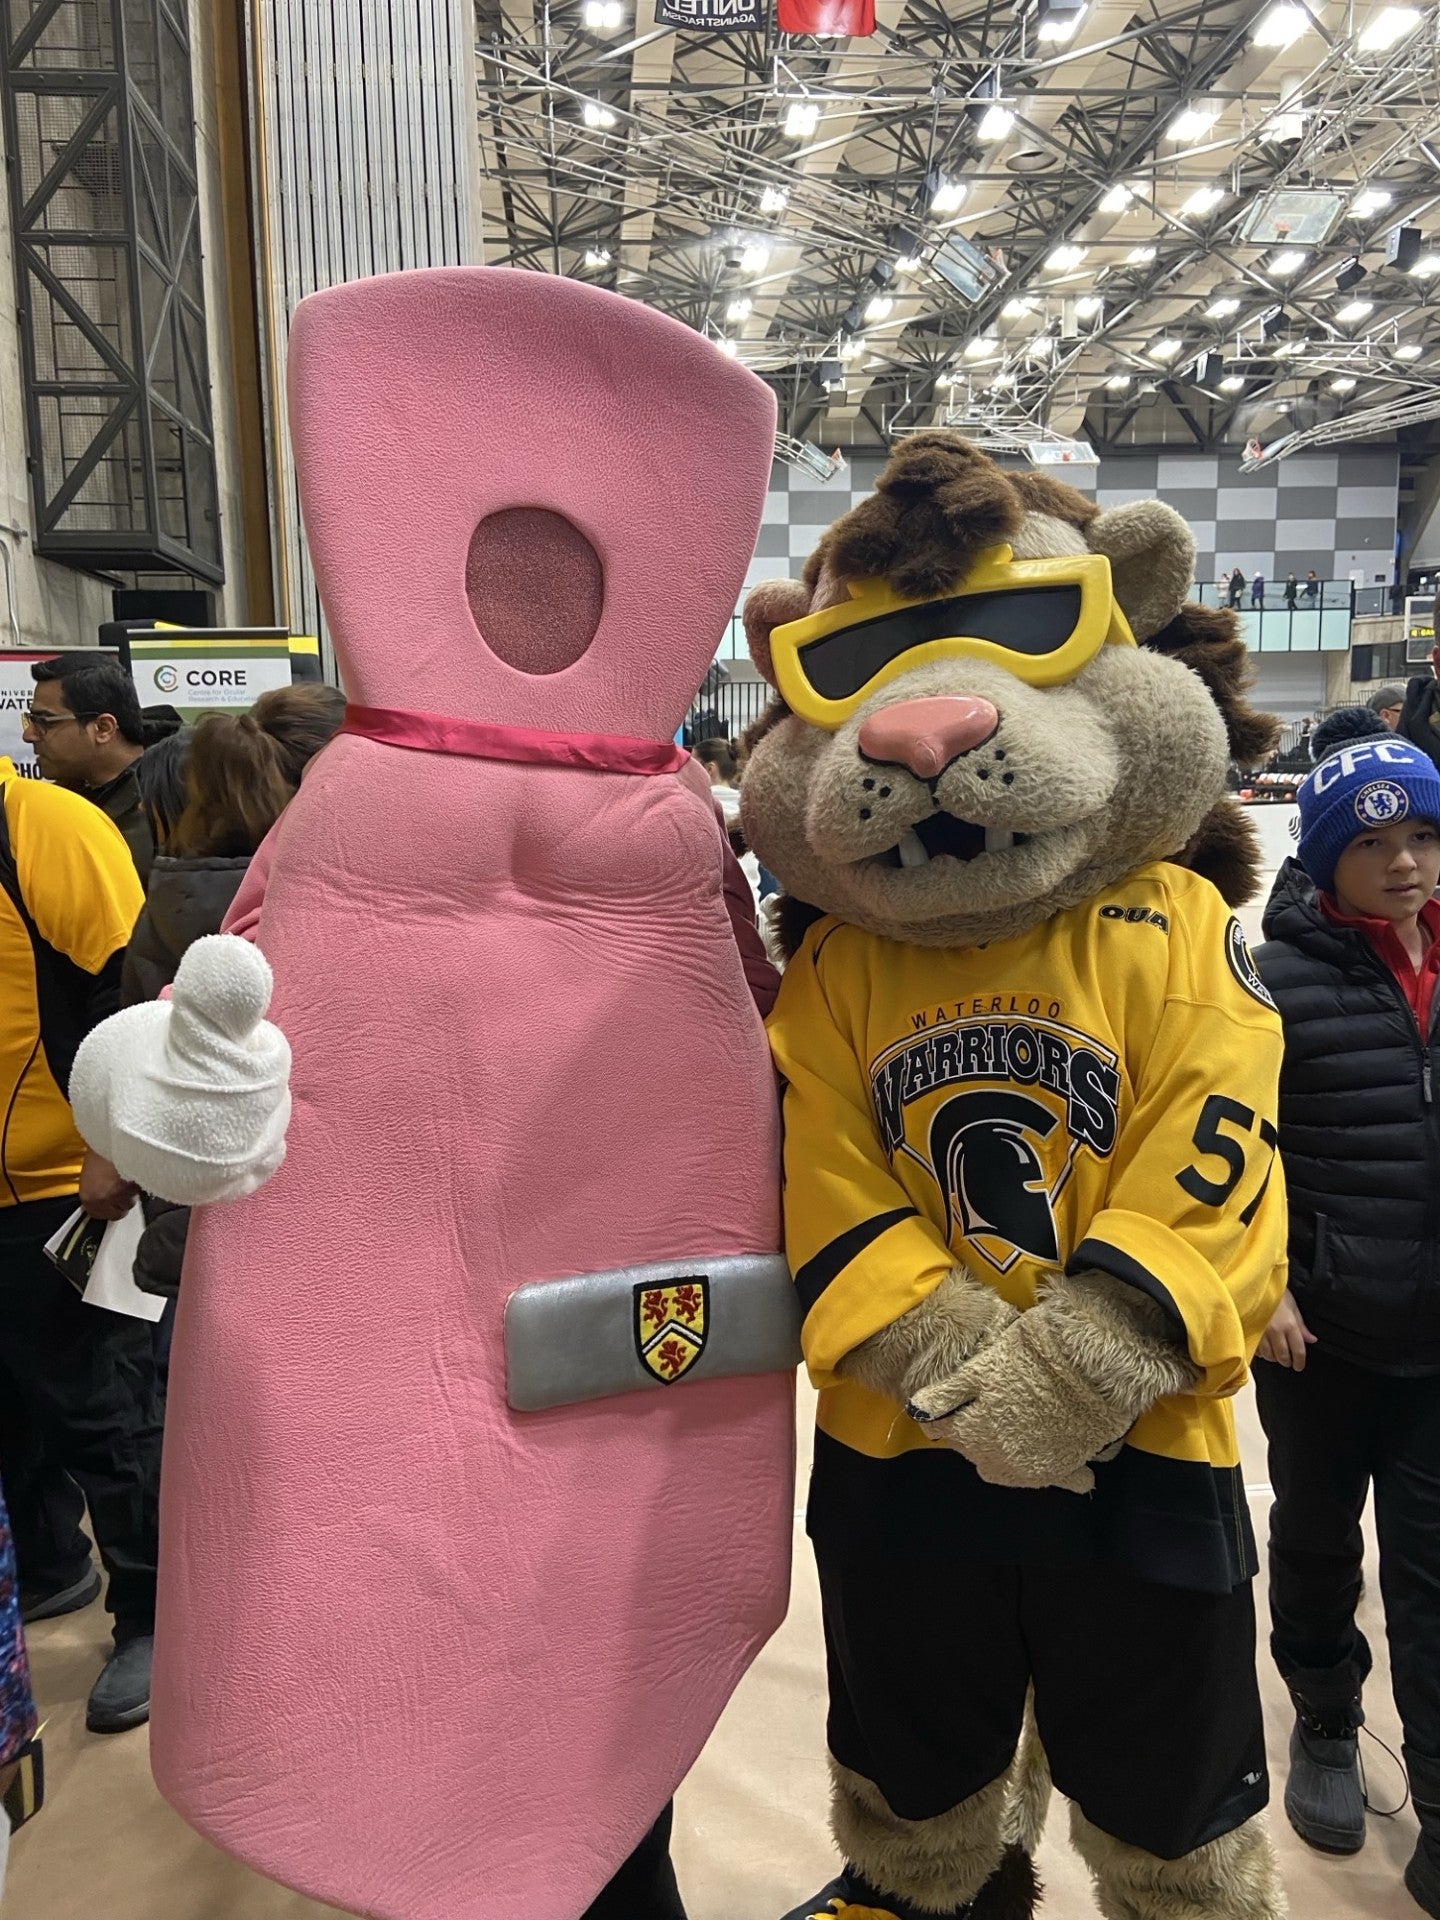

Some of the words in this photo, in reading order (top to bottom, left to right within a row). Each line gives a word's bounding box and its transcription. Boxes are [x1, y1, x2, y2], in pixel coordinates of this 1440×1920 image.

[186, 670, 247, 686] CORE
[1313, 742, 1414, 796] CFC
[1360, 783, 1390, 799] CHELSEA
[1099, 904, 1168, 935] OUA
[911, 996, 1061, 1030] WATERLOO
[871, 1023, 1121, 1164] WARRIORS
